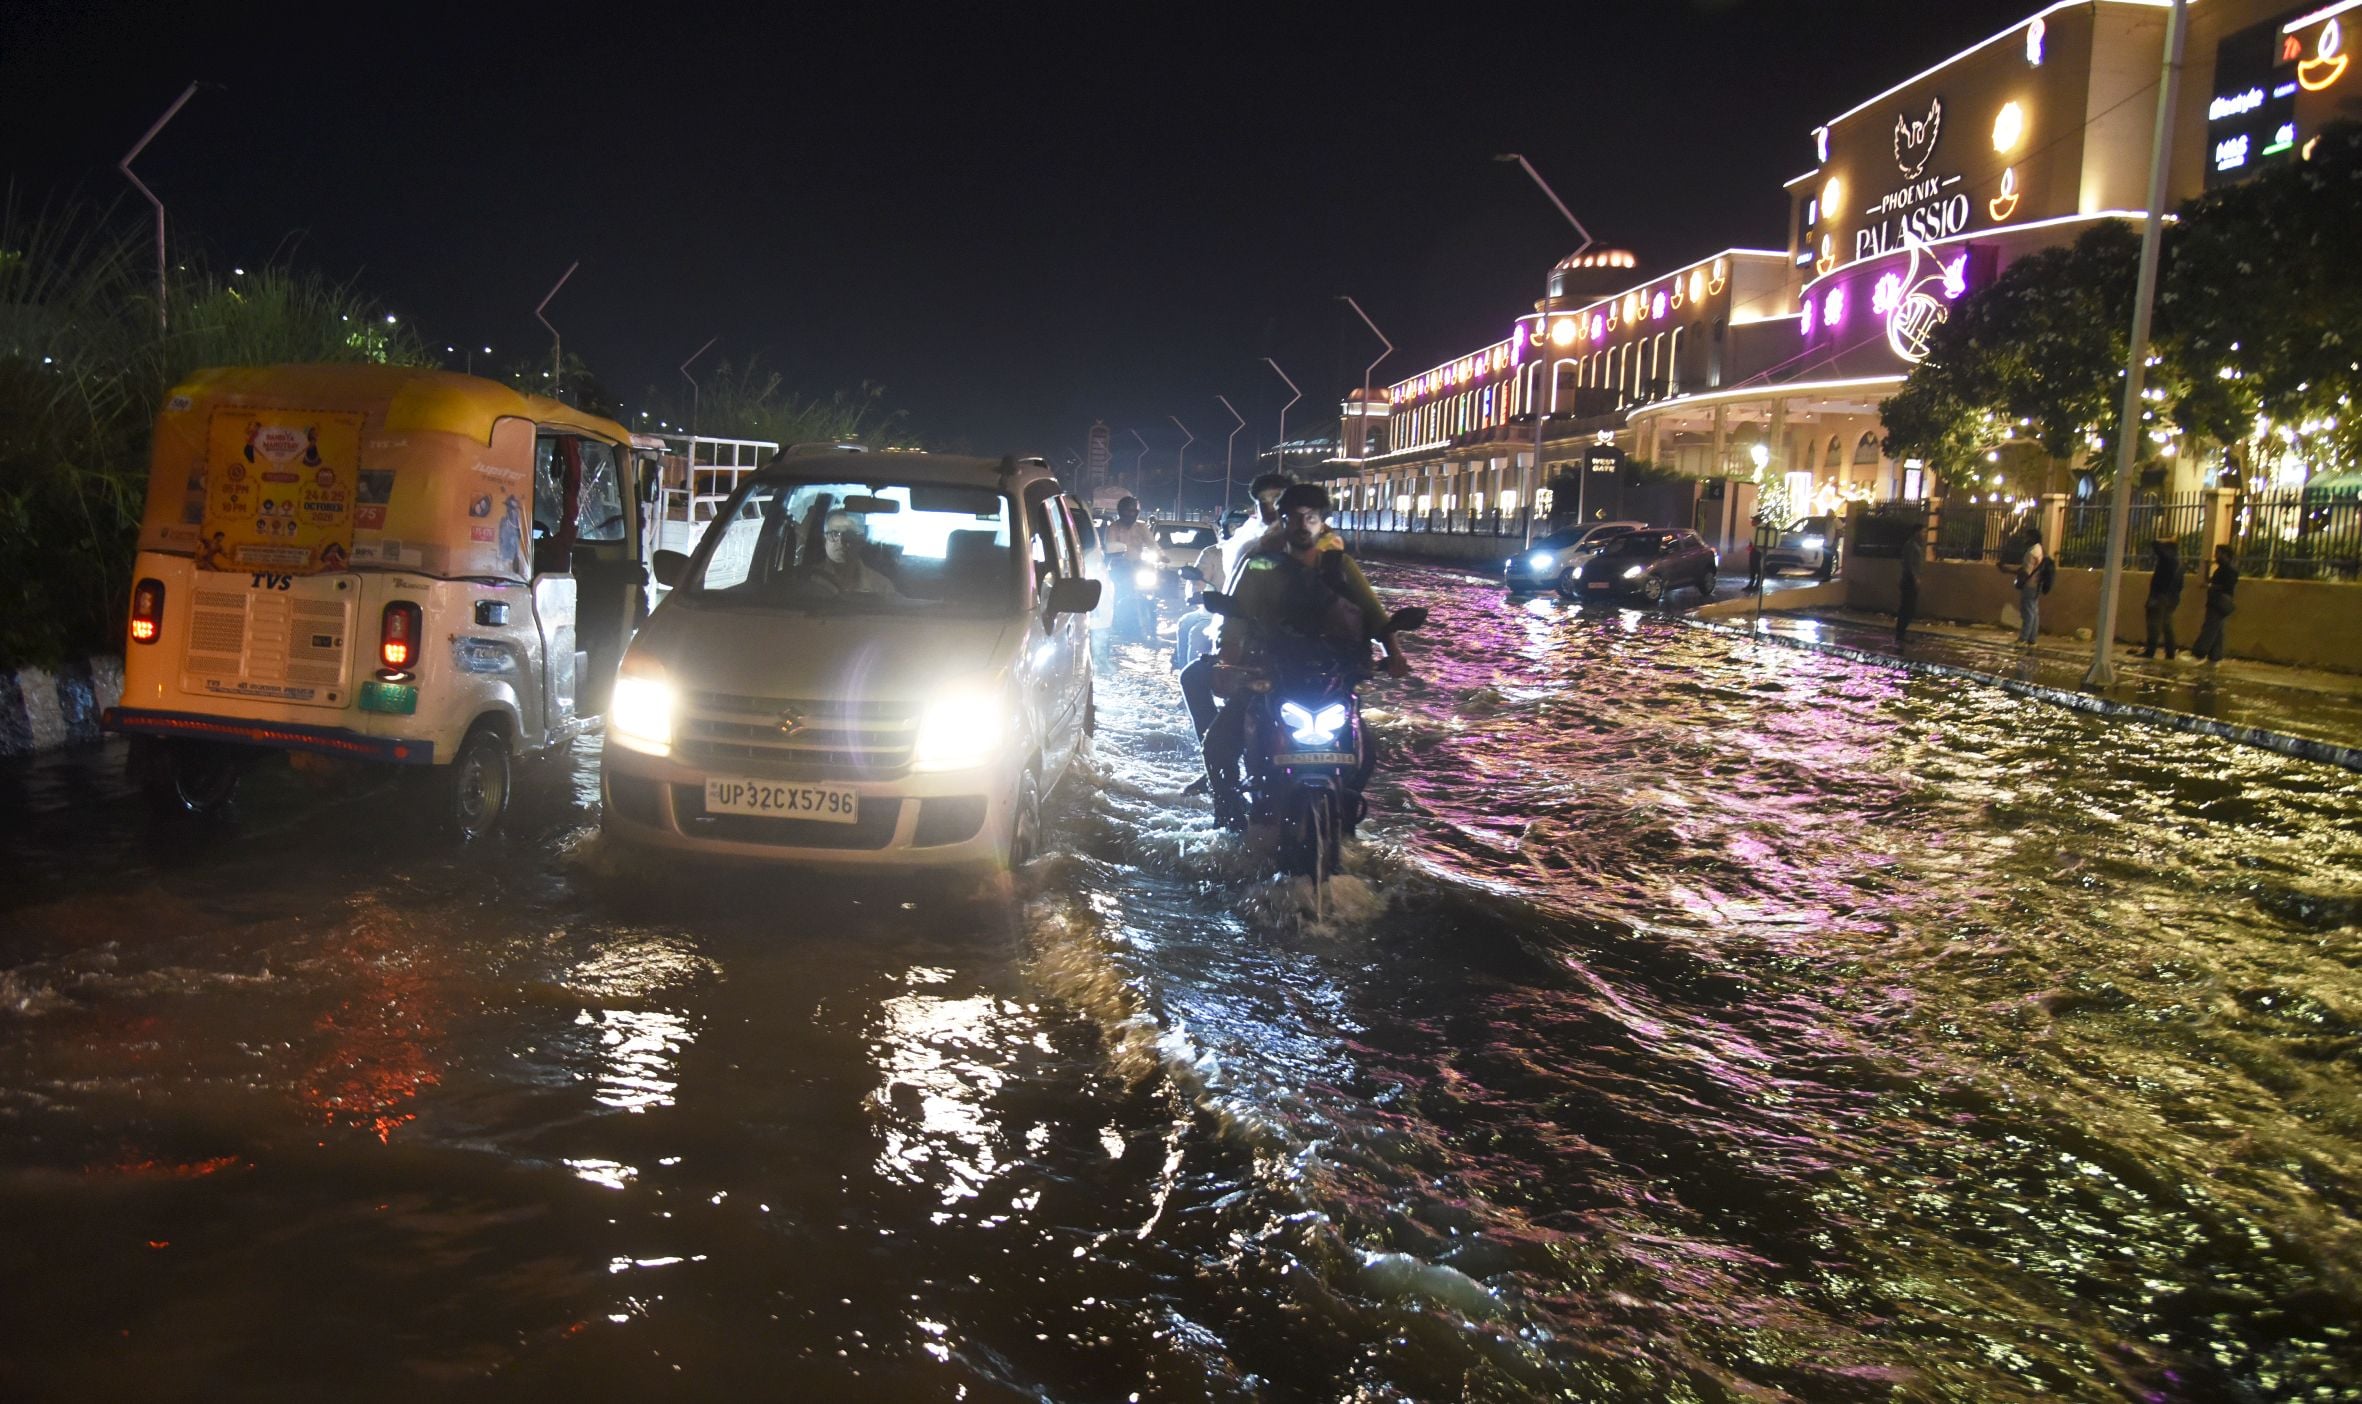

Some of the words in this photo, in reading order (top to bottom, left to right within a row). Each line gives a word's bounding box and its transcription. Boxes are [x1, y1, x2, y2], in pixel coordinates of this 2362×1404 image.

[1881, 176, 1939, 214] PHOENIX
[1856, 194, 1969, 260] PALASSIO
[1592, 465, 1616, 473] GATE
[251, 573, 293, 591] TVS
[719, 782, 853, 814] UP32CX5796
